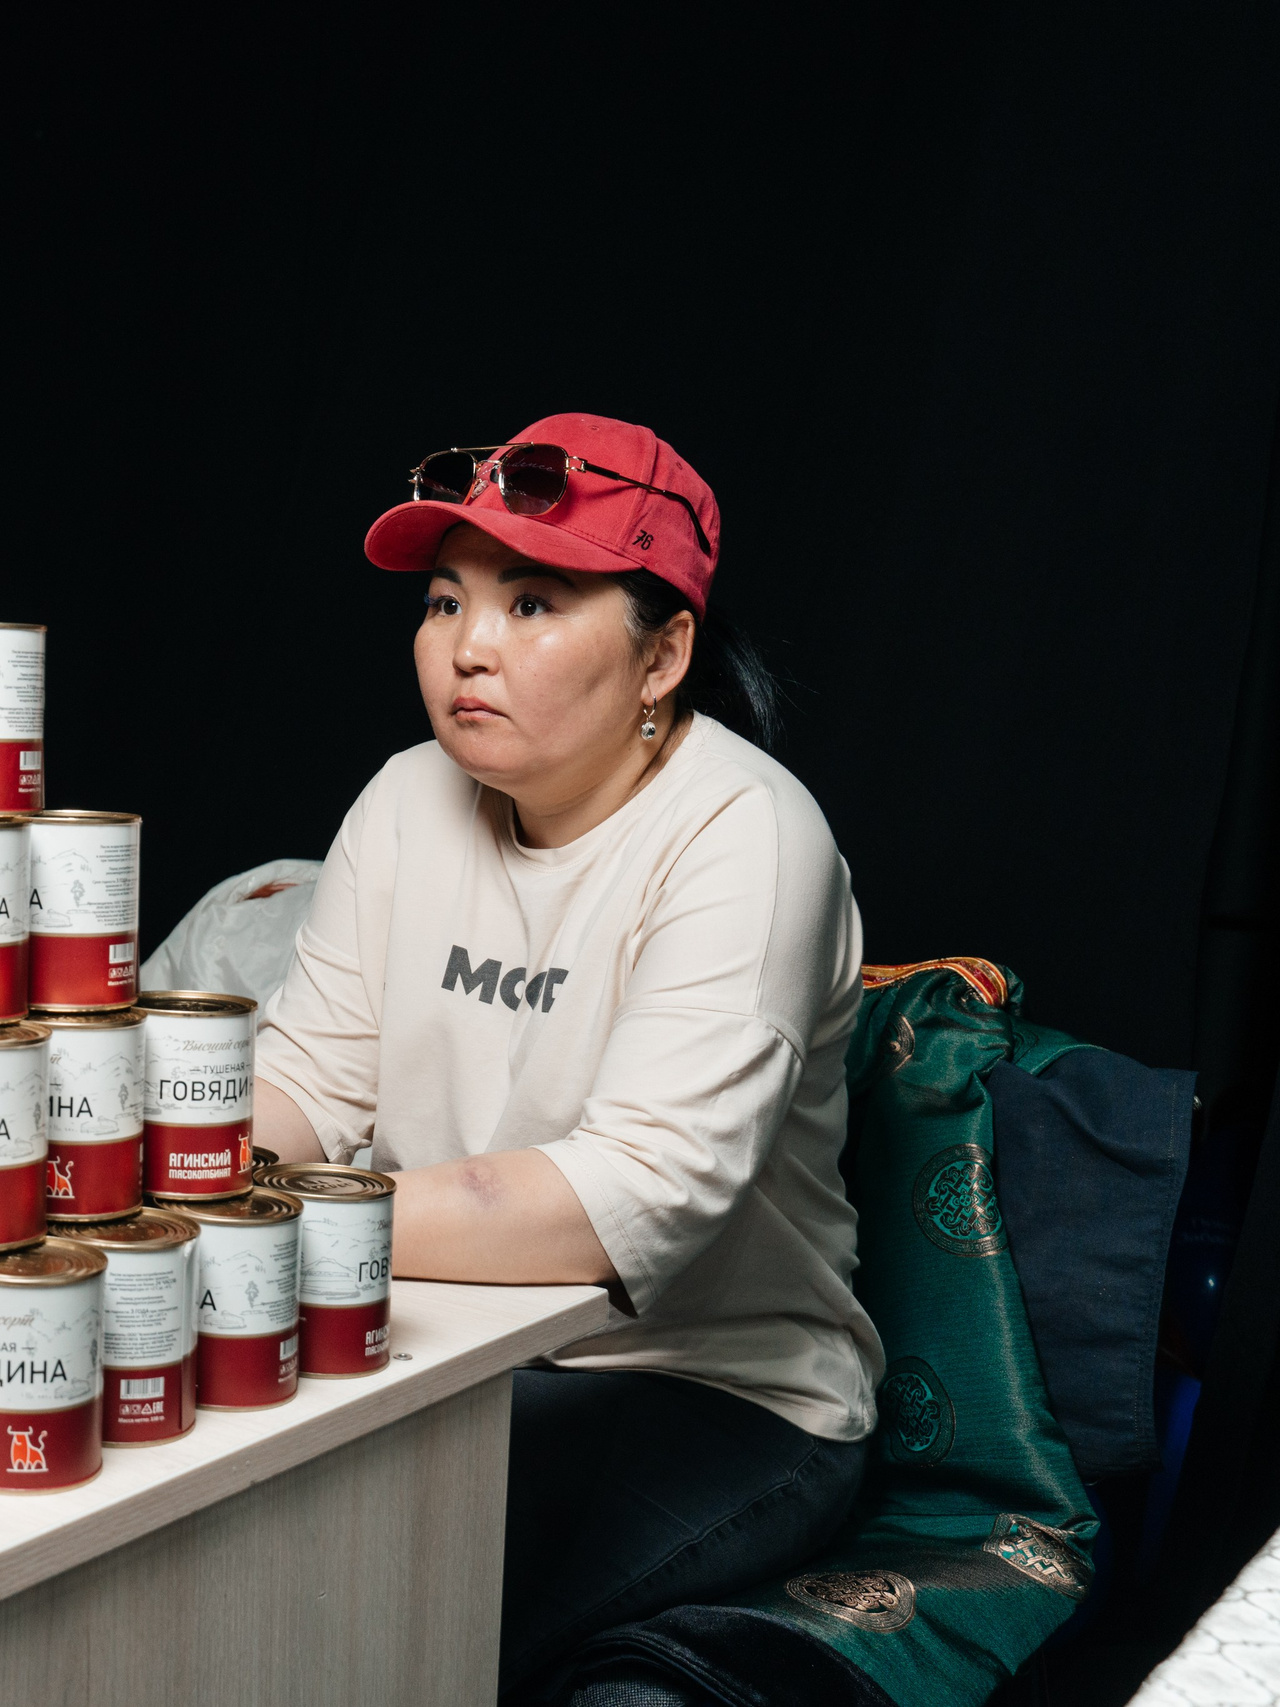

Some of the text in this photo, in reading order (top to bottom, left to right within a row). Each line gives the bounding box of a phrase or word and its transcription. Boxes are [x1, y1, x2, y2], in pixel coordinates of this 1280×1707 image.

[182, 1040, 233, 1054] Высший
[202, 1063, 244, 1074] ТУШЕНАЯ
[160, 1078, 250, 1104] ГОВЯДИ
[169, 1149, 231, 1168] АГИНСКИЙ
[168, 1167, 231, 1180] МЯСОКОМБИНАТ
